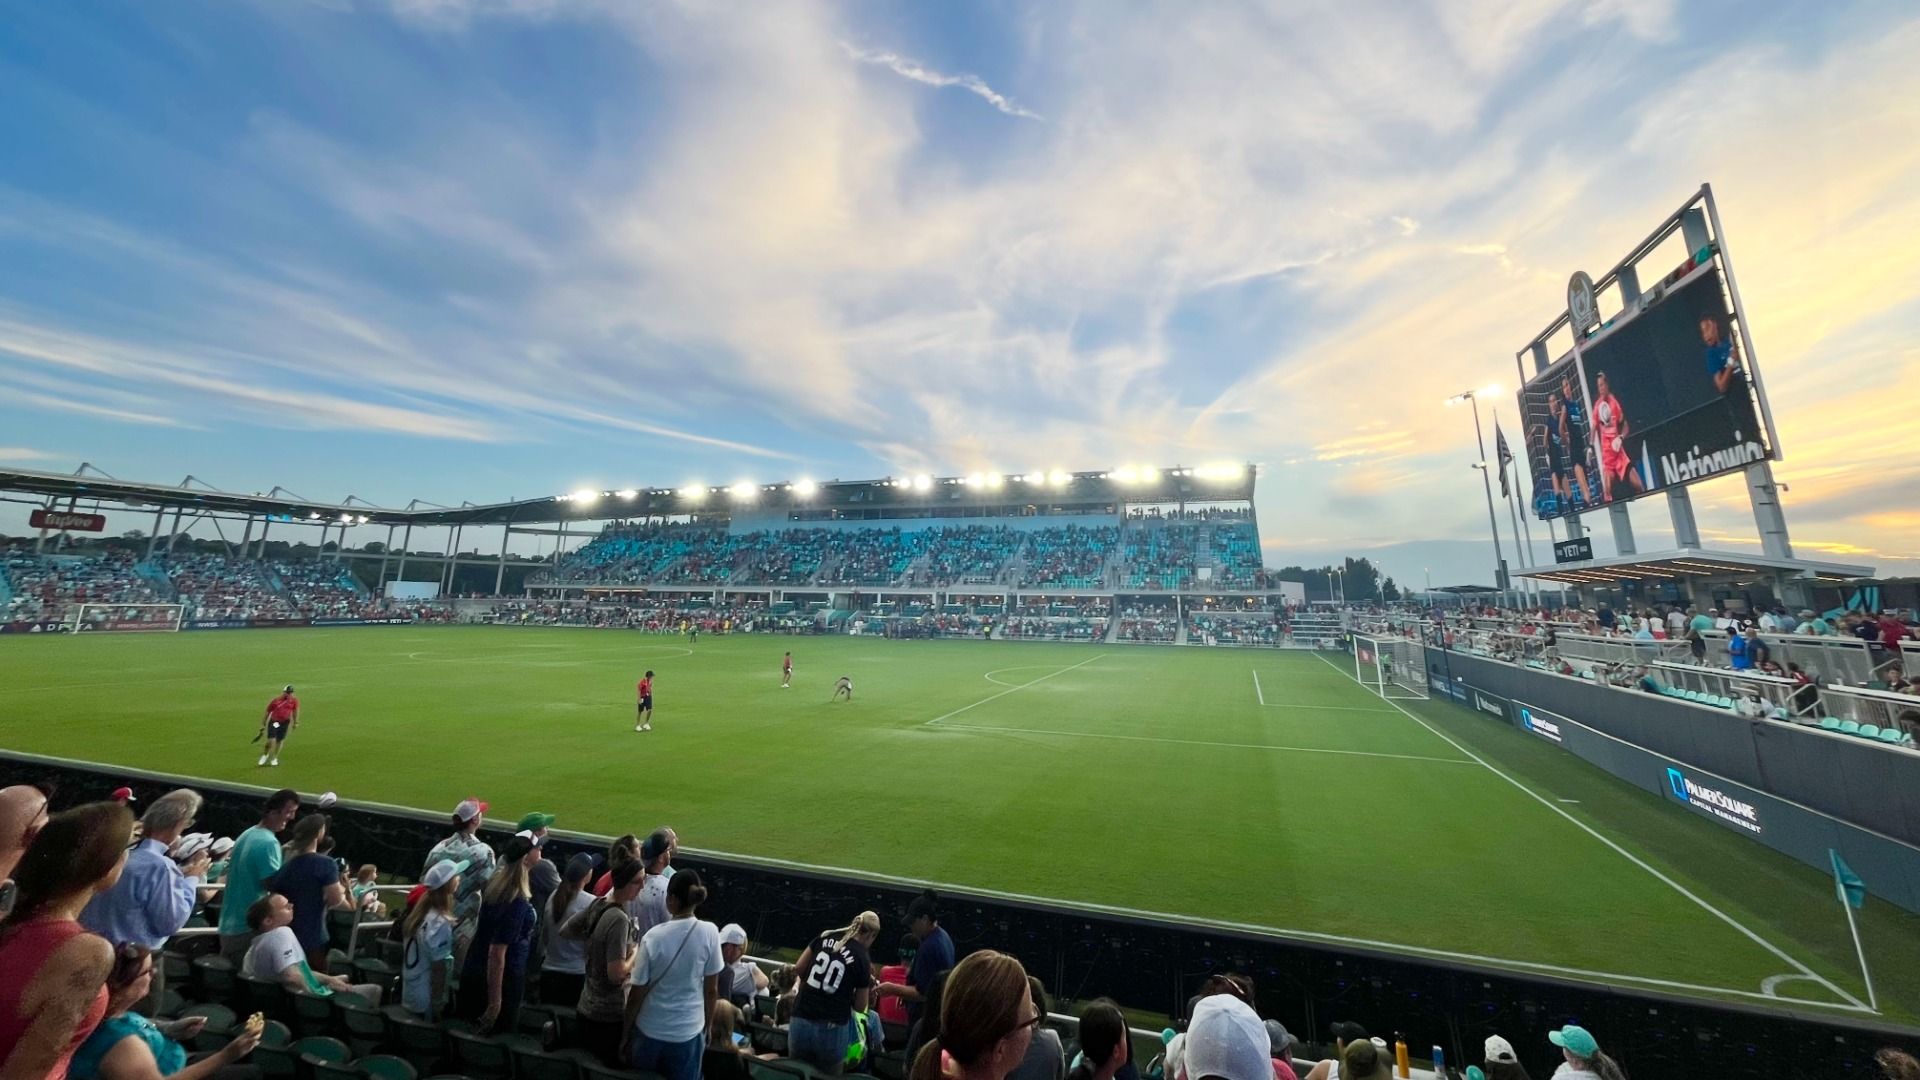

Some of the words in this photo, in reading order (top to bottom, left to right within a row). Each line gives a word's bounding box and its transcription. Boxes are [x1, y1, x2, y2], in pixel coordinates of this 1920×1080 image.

[1562, 544, 1580, 558] YETI
[1714, 808, 1761, 834] MANAGEMENT
[806, 950, 845, 993] 20
